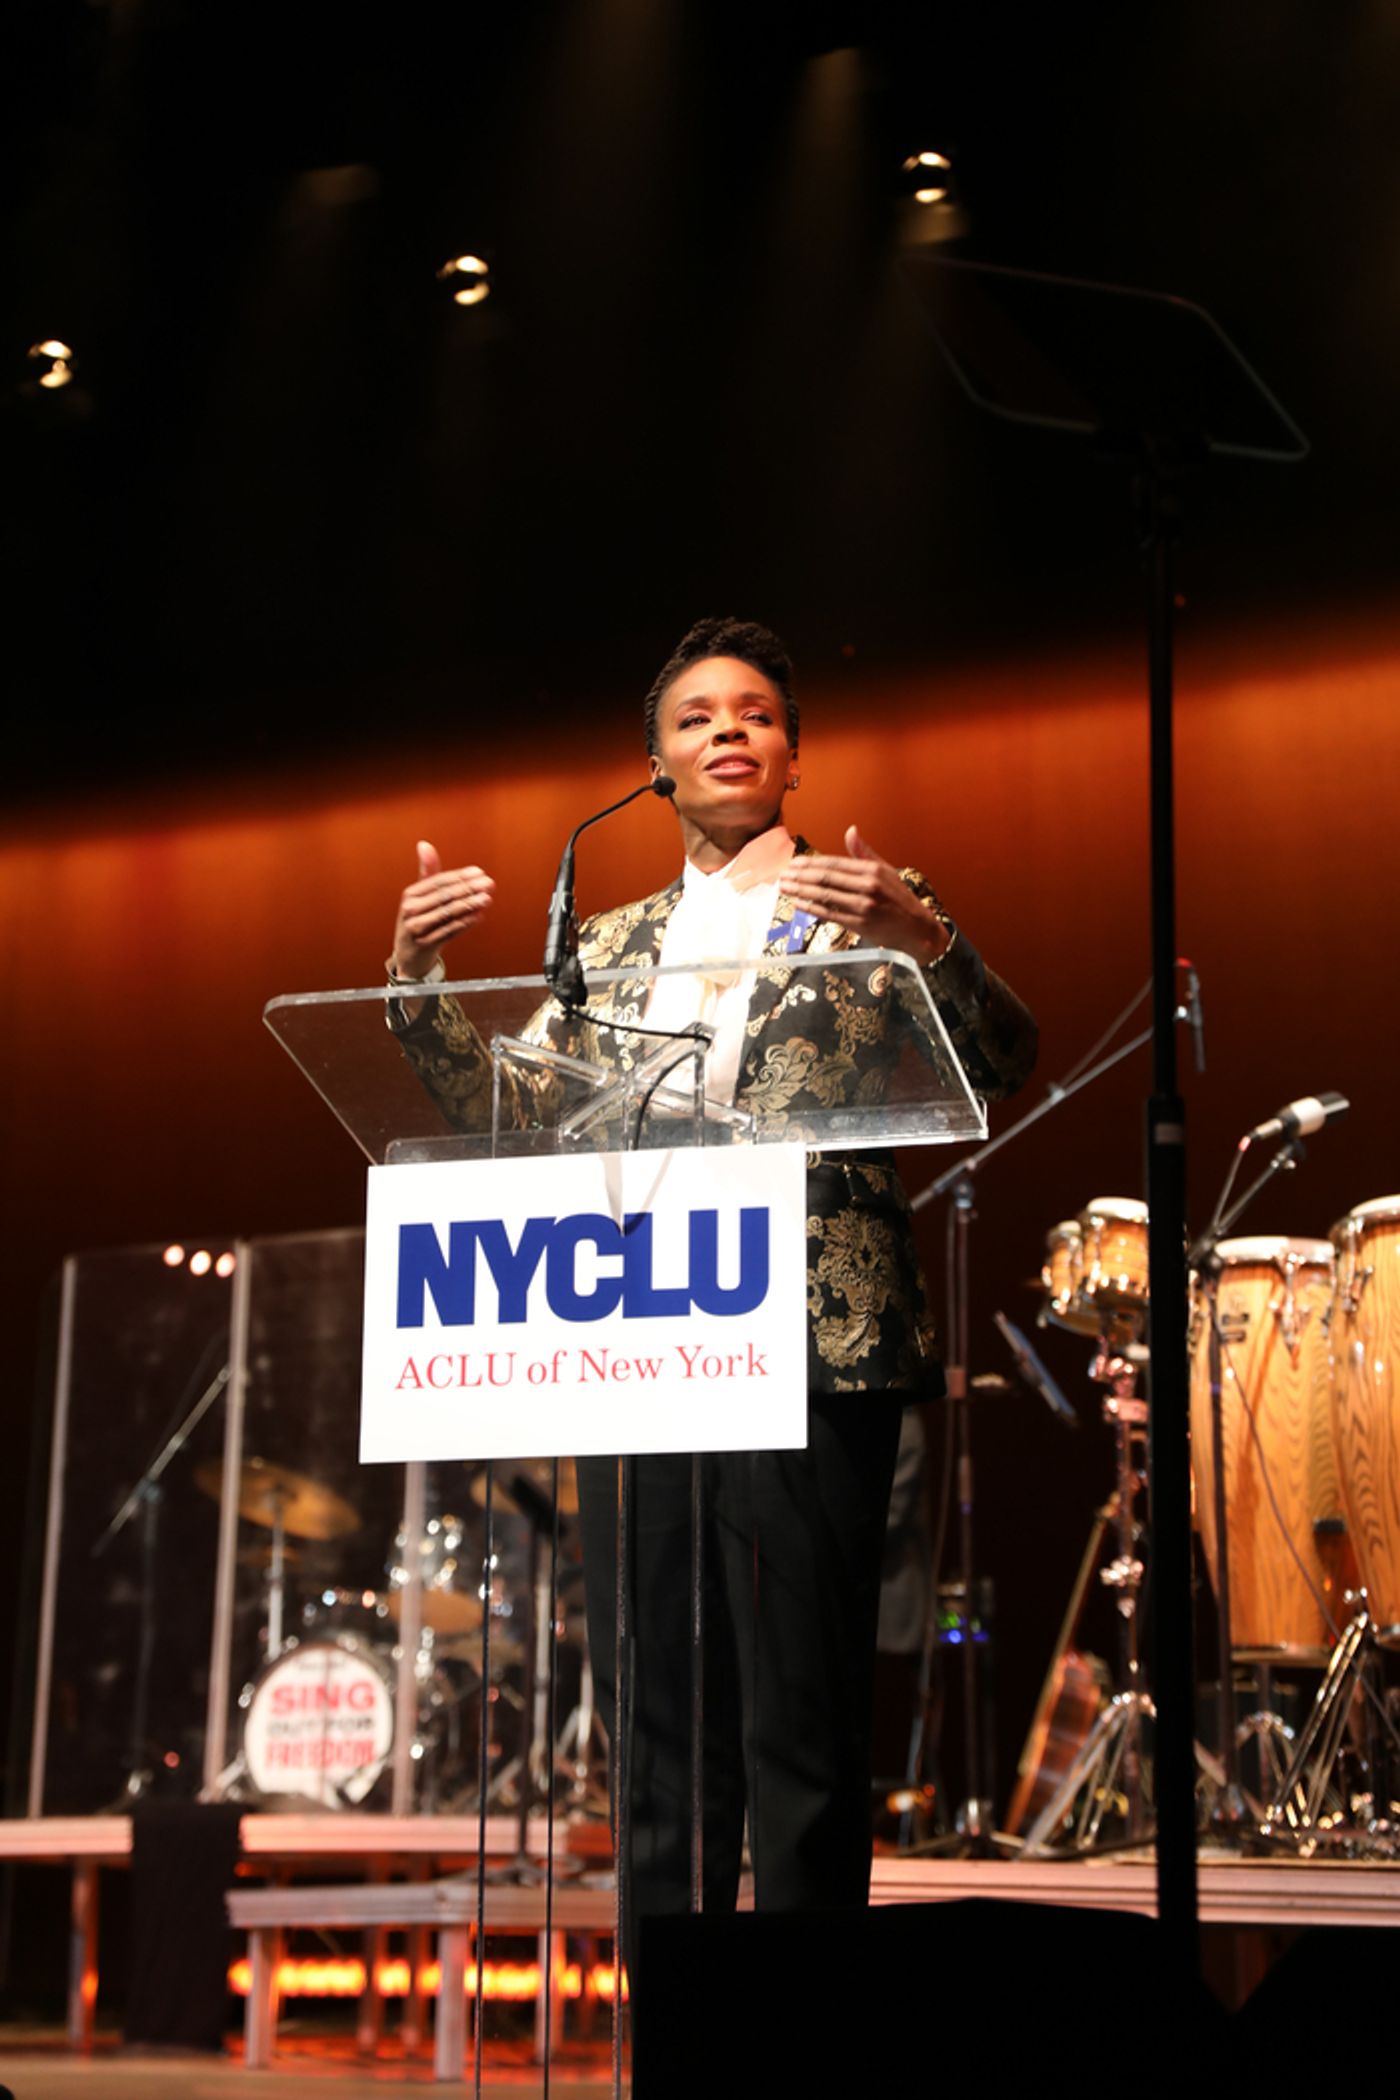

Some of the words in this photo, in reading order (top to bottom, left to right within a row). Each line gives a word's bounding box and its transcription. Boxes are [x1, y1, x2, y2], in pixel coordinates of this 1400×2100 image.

[396, 1206, 770, 1329] NYCLU
[395, 1351, 515, 1390] ACLU
[527, 1350, 568, 1384] of
[578, 1348, 664, 1383] New
[676, 1342, 769, 1379] York
[271, 1681, 376, 1716] SING
